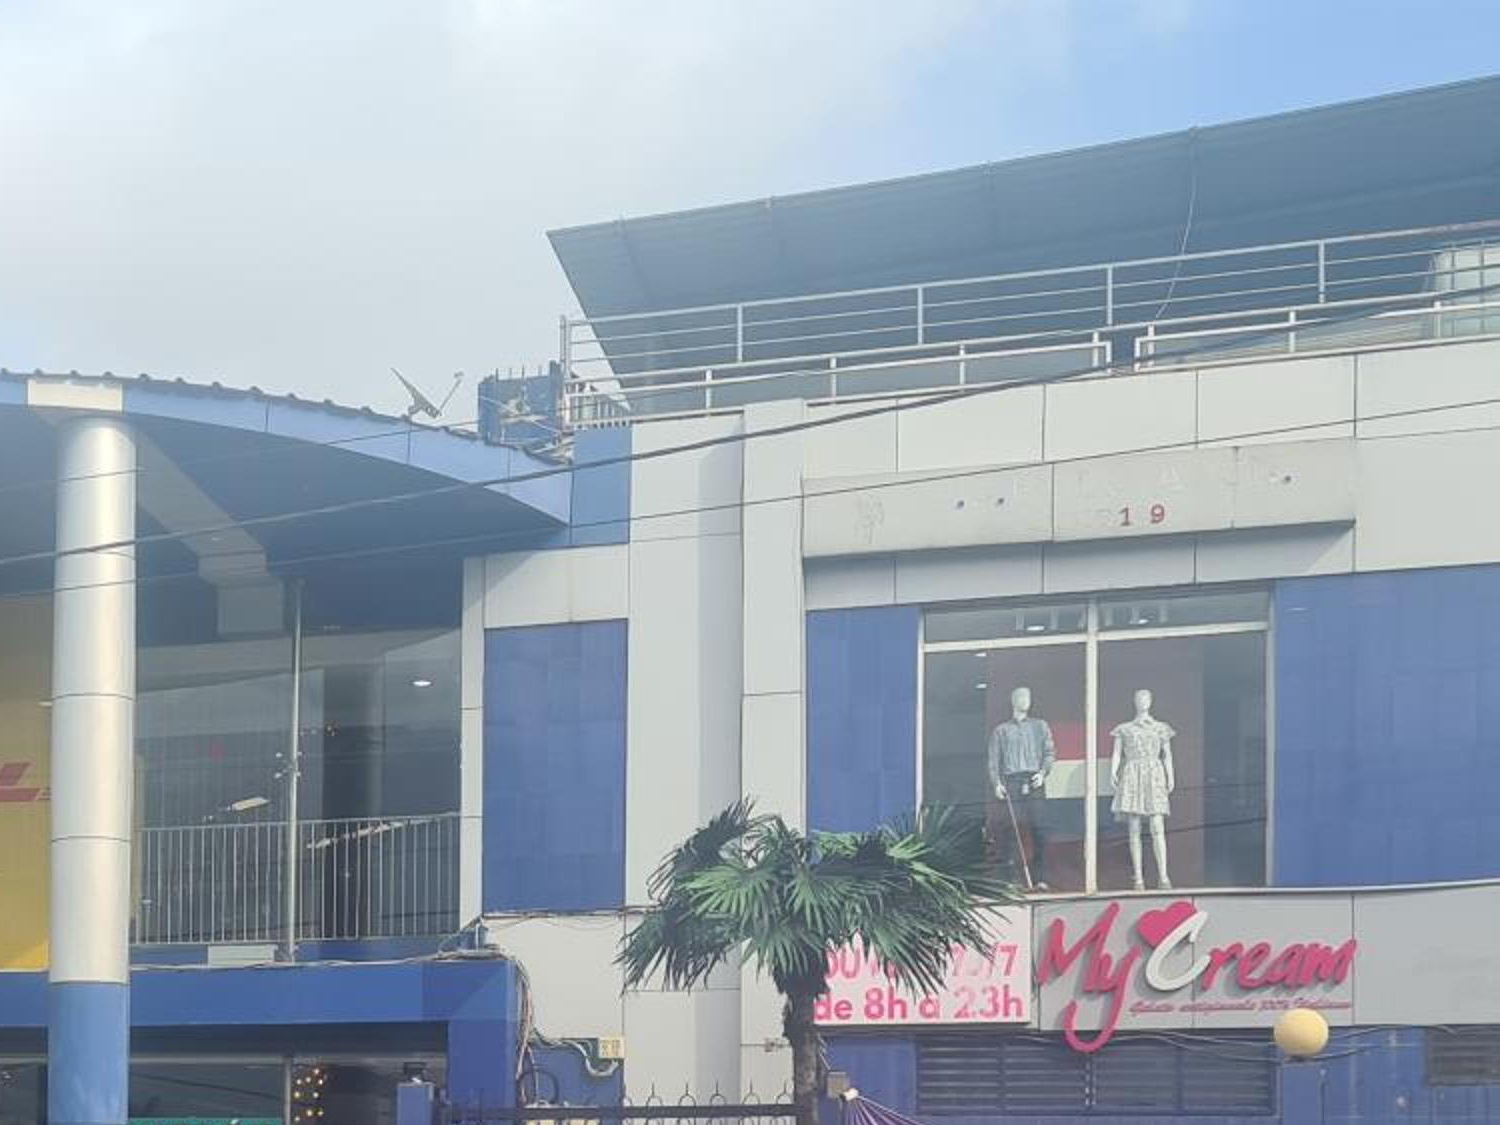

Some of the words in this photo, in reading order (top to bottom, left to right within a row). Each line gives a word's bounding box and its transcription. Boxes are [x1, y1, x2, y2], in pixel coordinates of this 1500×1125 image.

[814, 991, 852, 1020] de
[864, 985, 908, 1019] 8h
[953, 984, 1024, 1018] 23h
[1036, 902, 1141, 1052] My
[1145, 911, 1357, 992] Cream
